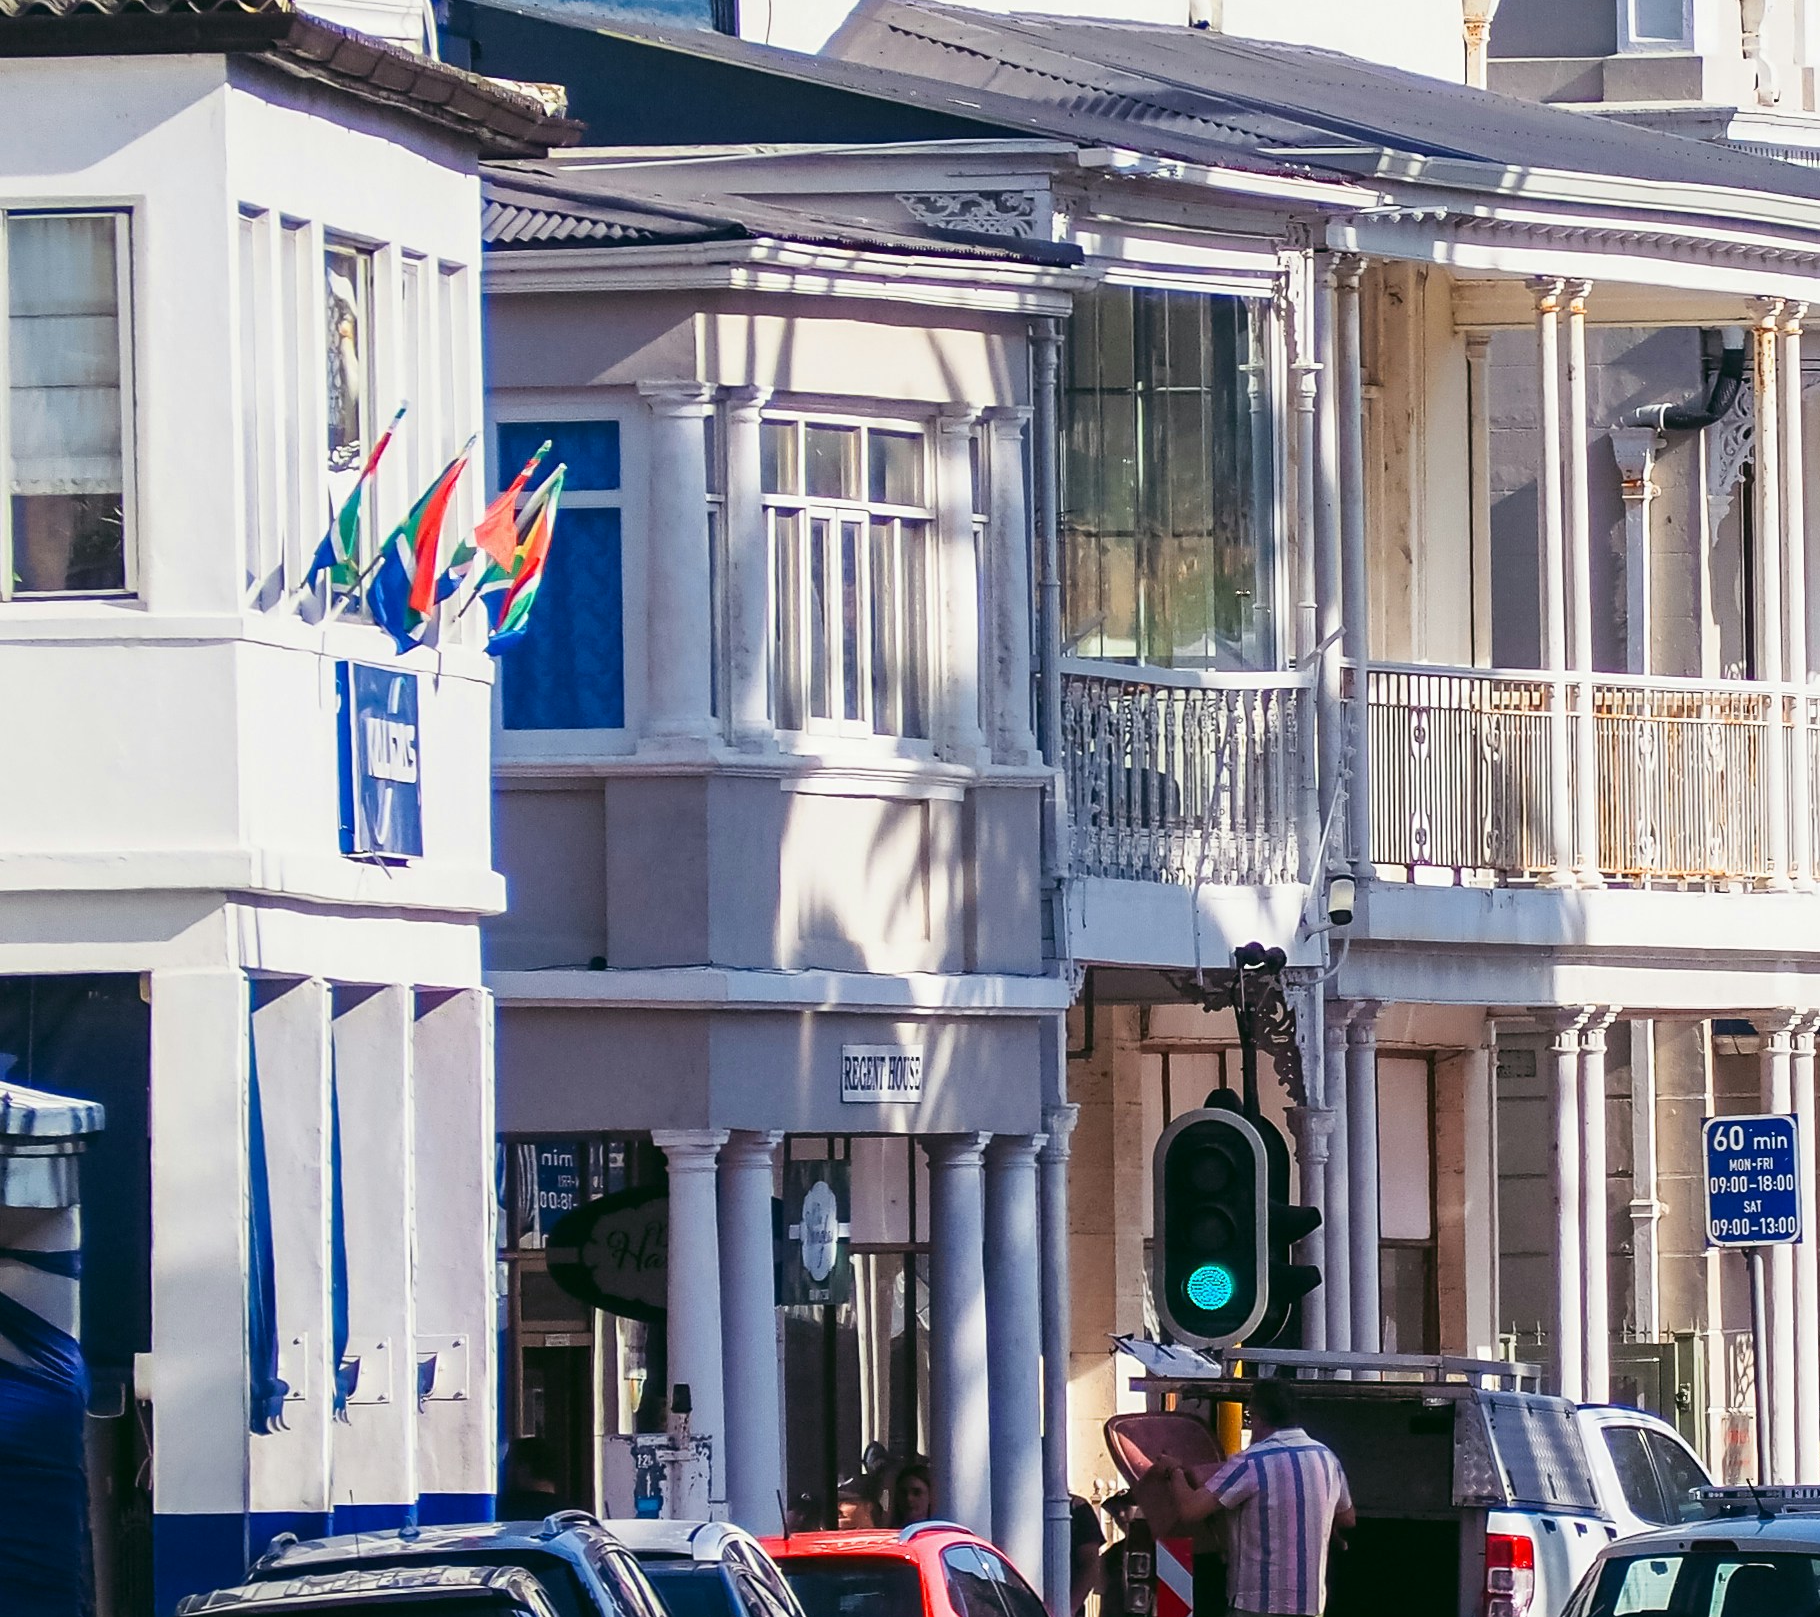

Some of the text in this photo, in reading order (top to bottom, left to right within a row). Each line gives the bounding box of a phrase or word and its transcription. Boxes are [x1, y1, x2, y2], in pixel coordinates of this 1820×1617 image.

[844, 1055, 921, 1091] REGENT HOUSE
[1713, 1126, 1788, 1151] 60 min
[1729, 1157, 1774, 1172] MON-FRI
[1710, 1174, 1794, 1194] 09:00-18:00
[1743, 1200, 1762, 1213] SAT
[1712, 1216, 1796, 1236] 09:00-13:00
